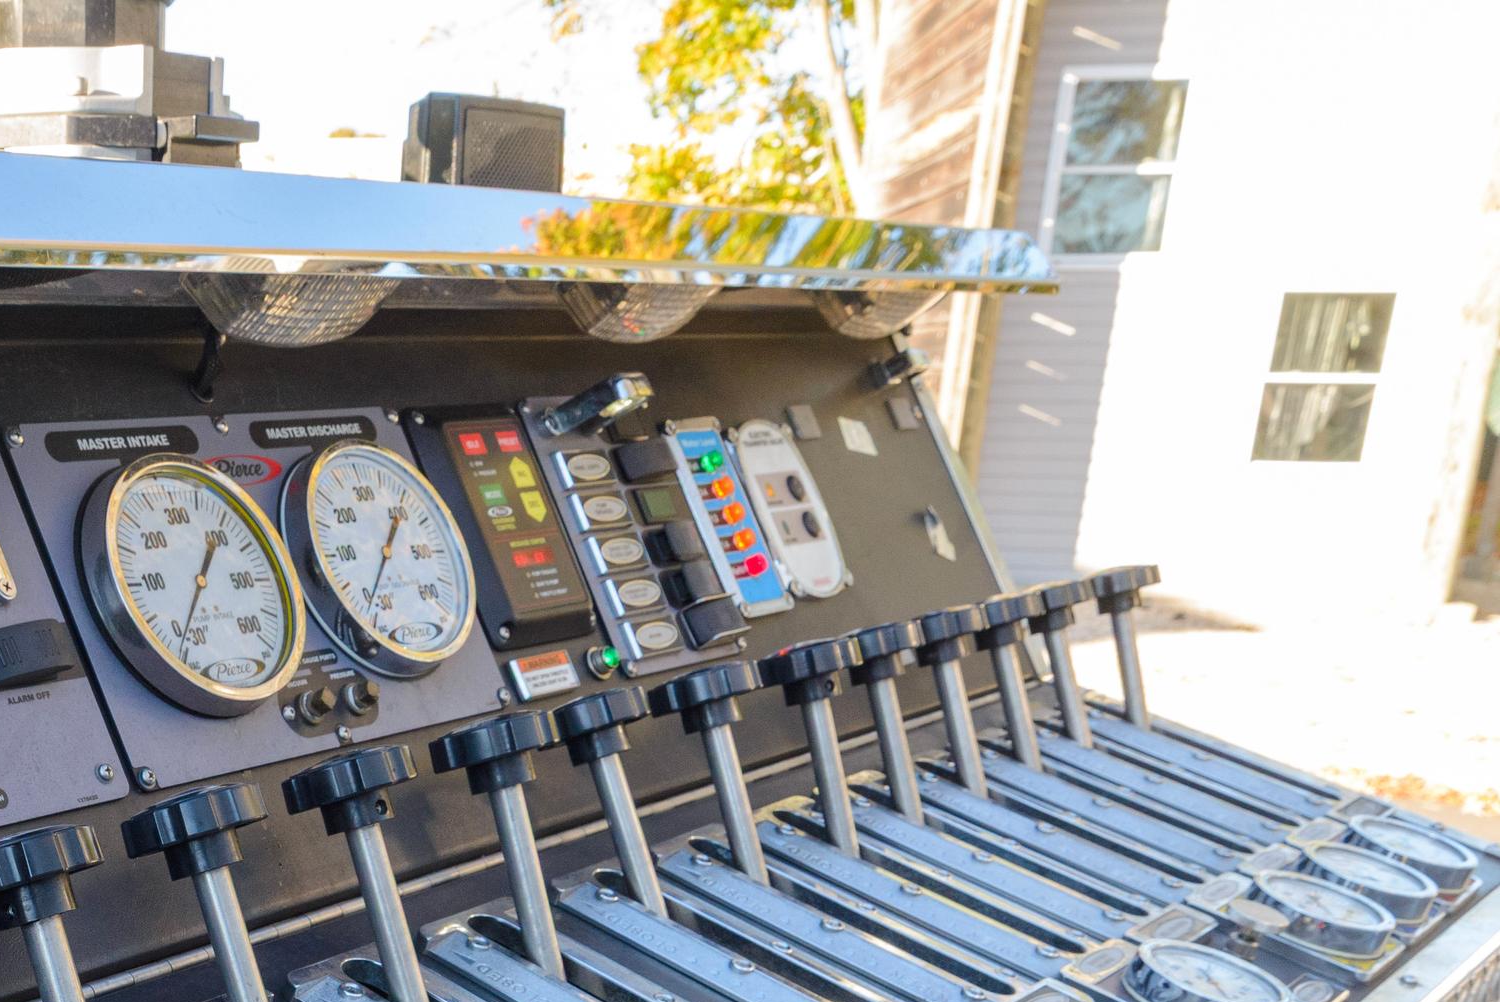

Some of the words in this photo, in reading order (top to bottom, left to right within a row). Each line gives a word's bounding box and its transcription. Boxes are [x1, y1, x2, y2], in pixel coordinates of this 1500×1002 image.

[266, 427, 307, 440] MASTER
[308, 422, 362, 438] DISCHARGE
[77, 436, 125, 451] MASTER
[127, 434, 170, 448] INTAKE
[214, 459, 264, 478] Pierce
[353, 485, 376, 502] 300
[164, 506, 190, 525] 300
[333, 507, 357, 524] 200
[140, 530, 167, 549] 200
[336, 545, 357, 562] 100
[410, 545, 432, 561] 500
[142, 571, 165, 591] 100
[230, 571, 254, 589] 500
[418, 583, 439, 601] 600
[171, 619, 183, 638] 0
[237, 615, 261, 634] 600
[216, 662, 252, 680] Pierce
[8, 694, 30, 705] ALARM
[31, 691, 51, 702] OFF
